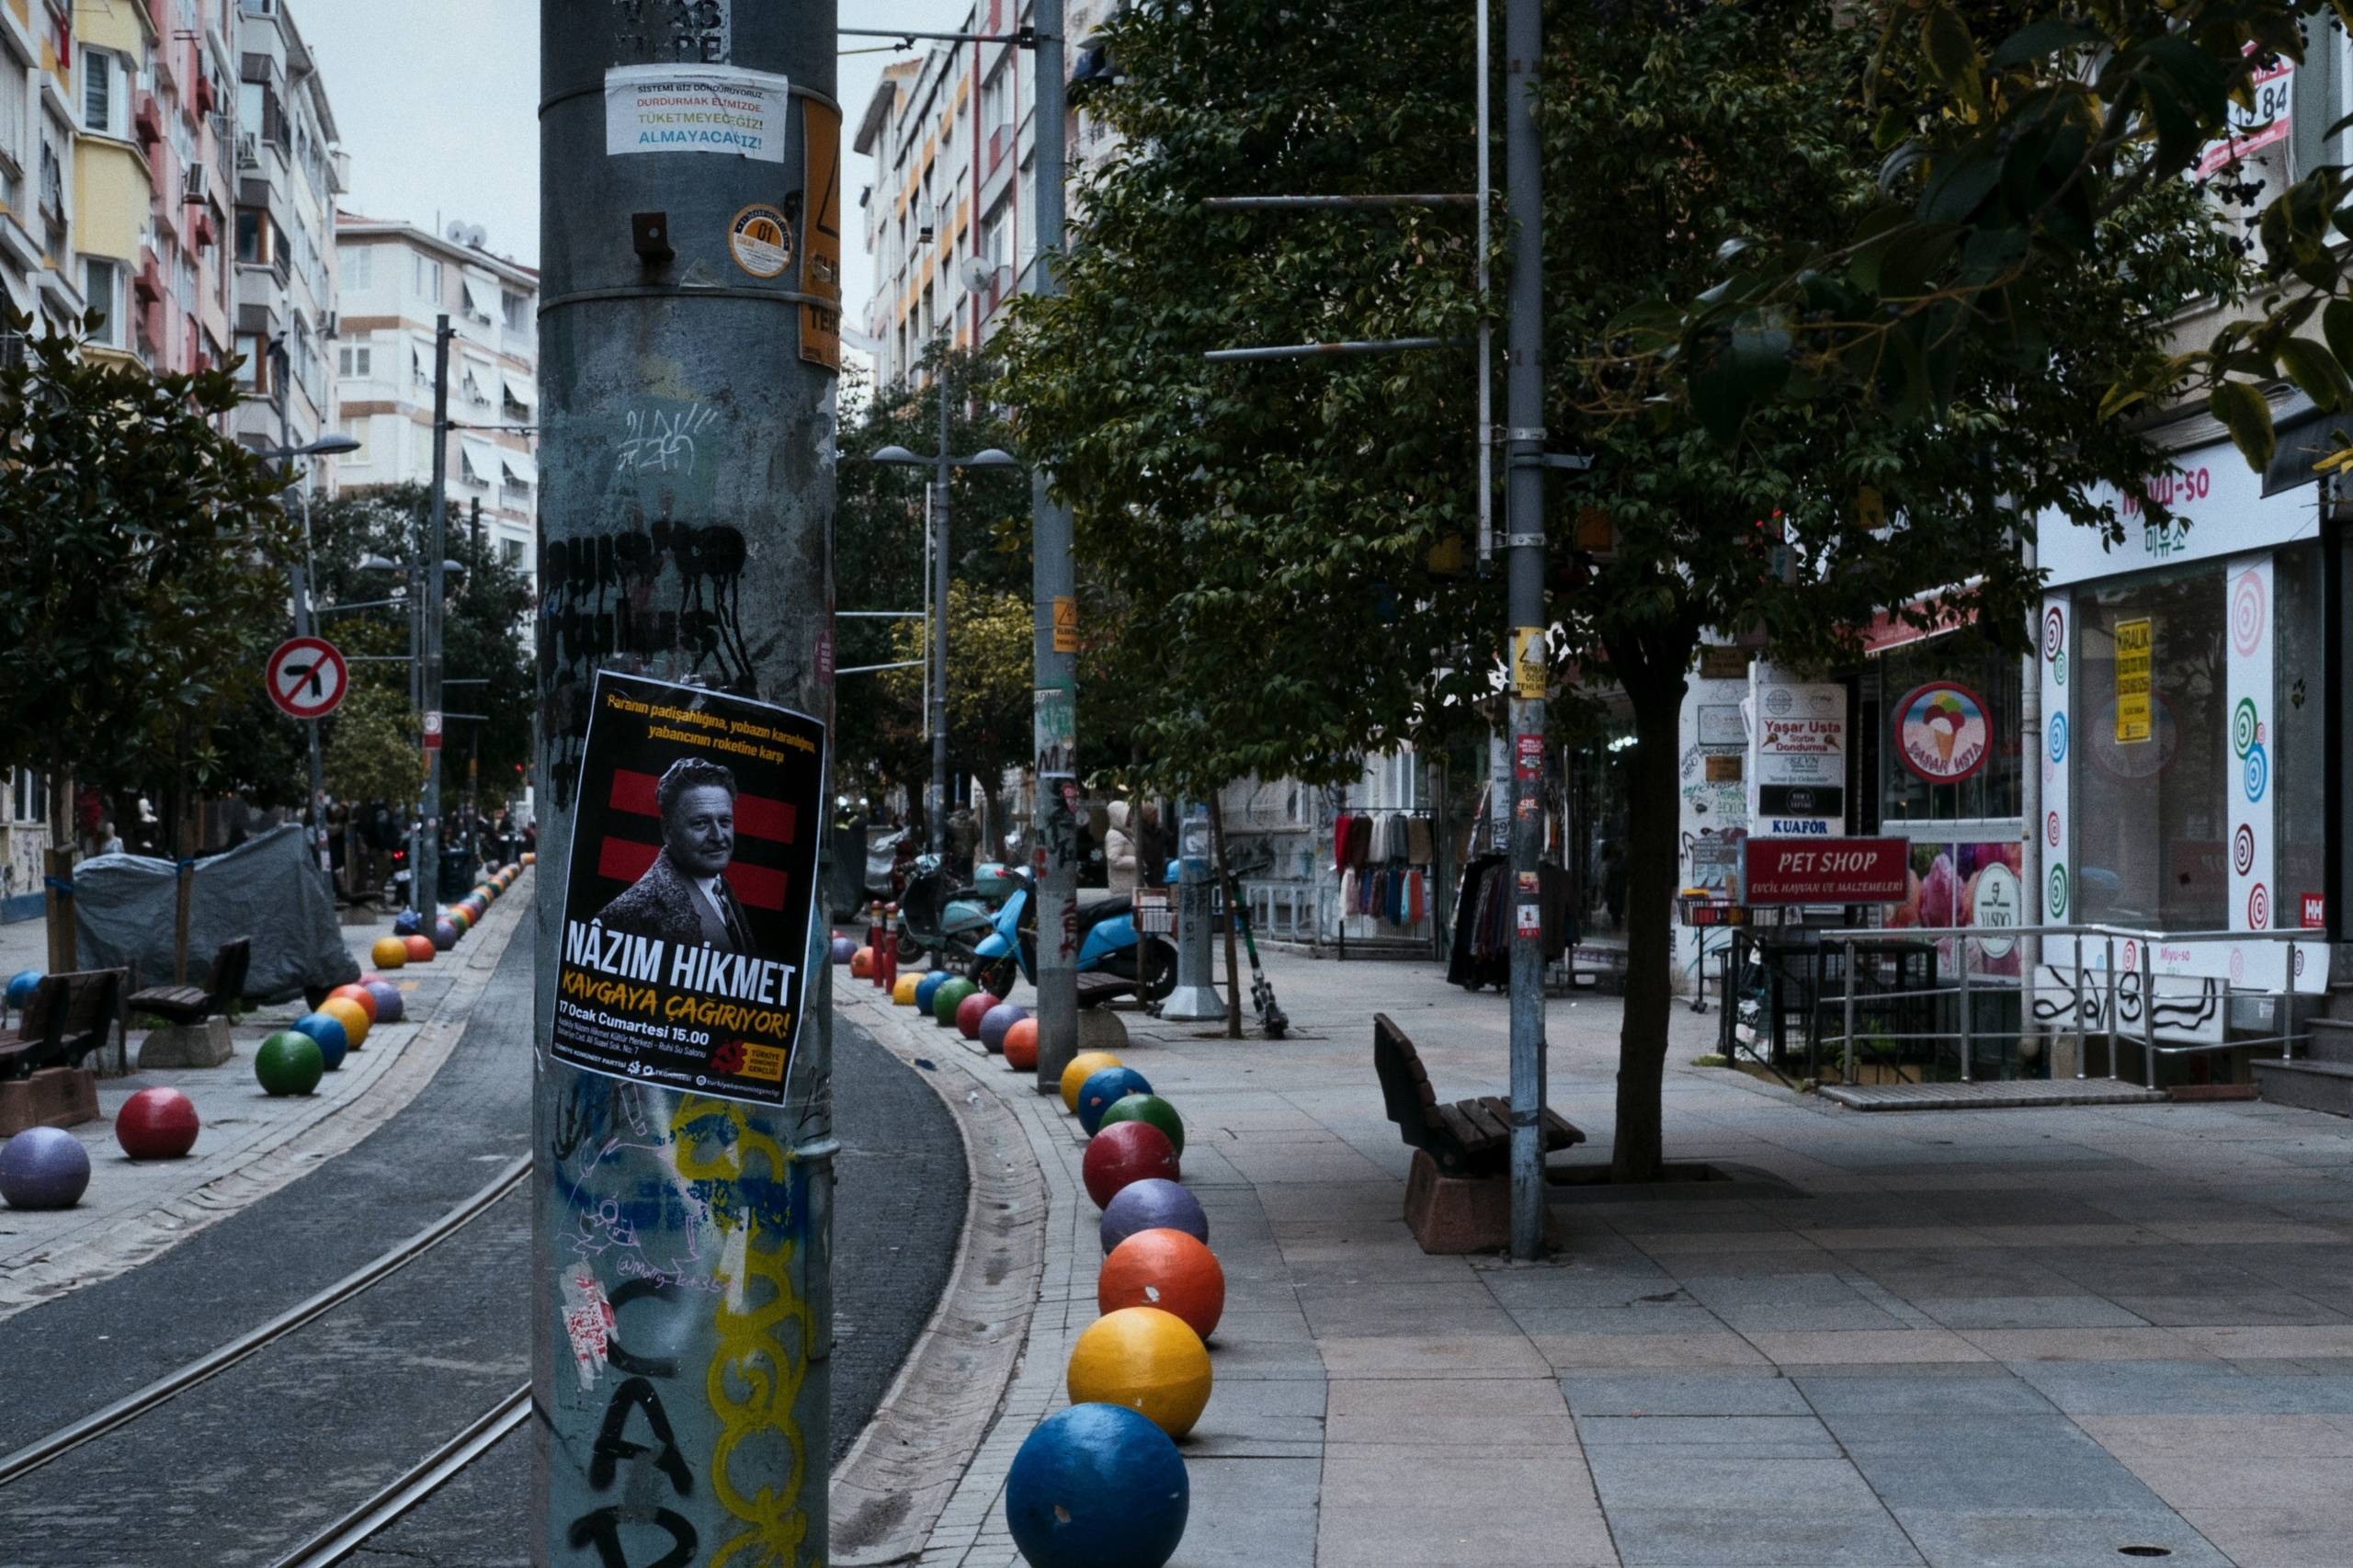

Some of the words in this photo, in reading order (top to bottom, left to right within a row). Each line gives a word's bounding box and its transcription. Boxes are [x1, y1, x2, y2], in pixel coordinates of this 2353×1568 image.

[637, 84, 674, 93] SİSTEMİ
[676, 84, 691, 92] BİZ
[637, 97, 708, 108] DURDURMAK
[2263, 82, 2287, 119] 84
[638, 111, 763, 131] TÜKETMEYECEĞİZ!
[607, 693, 649, 714] Paranın
[650, 702, 728, 732] padişahlığına,
[730, 719, 770, 739] yobazın
[771, 728, 816, 754] karanlığına,
[1765, 721, 1804, 734] Yaşar
[1809, 721, 1842, 733] Usta
[647, 724, 710, 747] yabancının
[712, 737, 757, 756] roketine
[758, 744, 785, 765] karşı
[1776, 743, 1828, 752] Dondurma
[1772, 820, 1827, 834] KUAFÖR
[1778, 852, 1816, 872] PET
[1819, 852, 1878, 872] SHOP
[1751, 881, 1779, 893] EVCİL
[1836, 880, 1904, 892] MALZEMELERİ
[2305, 899, 2323, 921] HH
[565, 917, 665, 983] NÂZIM
[669, 941, 796, 1007] HİKMET
[562, 969, 658, 1017] KAVGAYA
[665, 995, 791, 1039] ÇAĞIRIYOR!
[559, 999, 568, 1014] 17
[568, 1004, 597, 1023] Ocak
[598, 1012, 669, 1039] Cumartesi
[672, 1027, 710, 1046] 15.00
